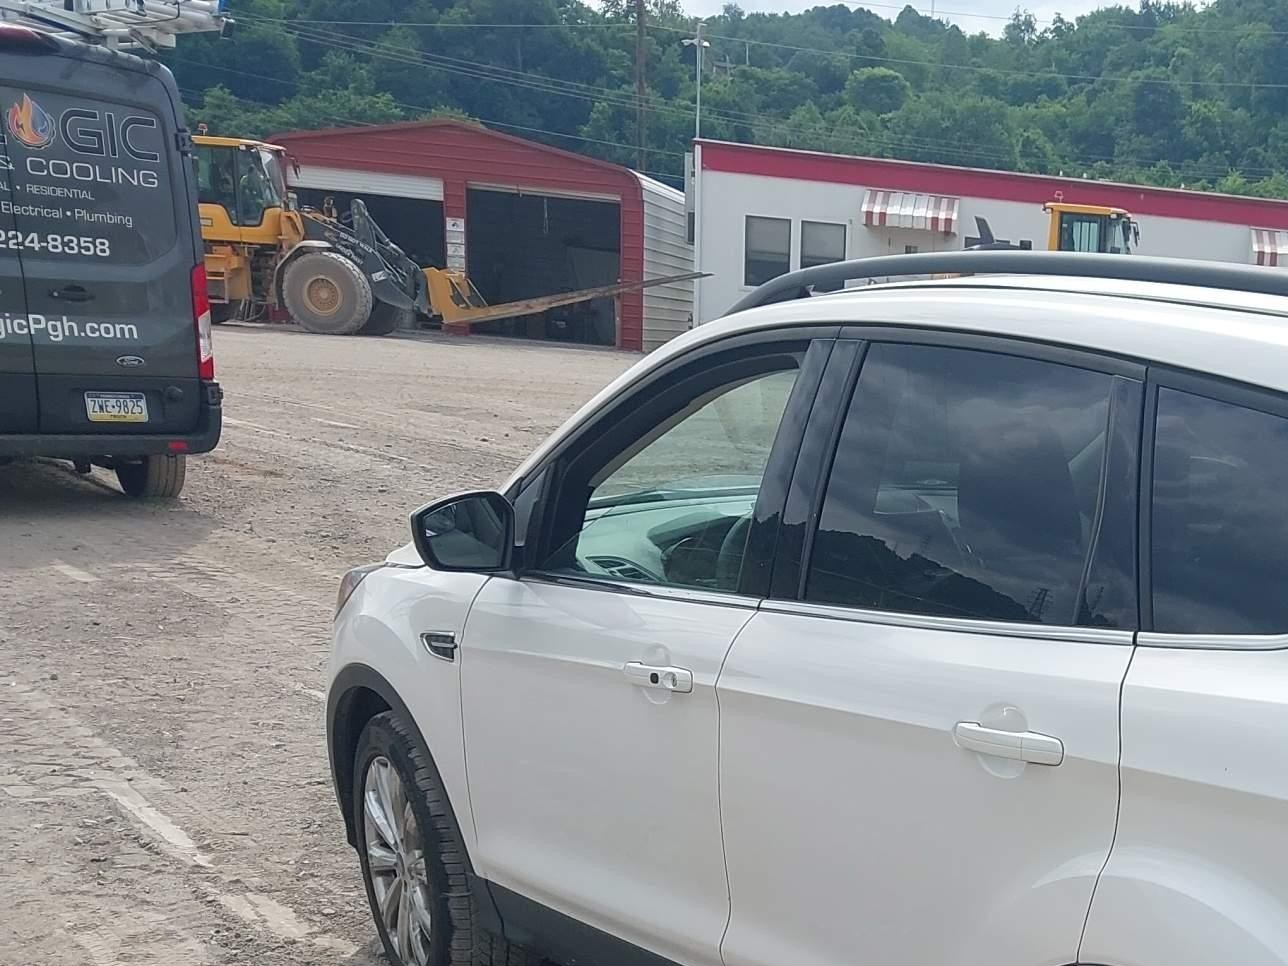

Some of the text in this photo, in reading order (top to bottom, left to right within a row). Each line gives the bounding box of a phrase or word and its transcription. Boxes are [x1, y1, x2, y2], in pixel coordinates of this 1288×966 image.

[26, 156, 159, 188] COOLING
[26, 183, 96, 200] RESIDENTIAL
[1, 200, 133, 228] Electrical Plumbing
